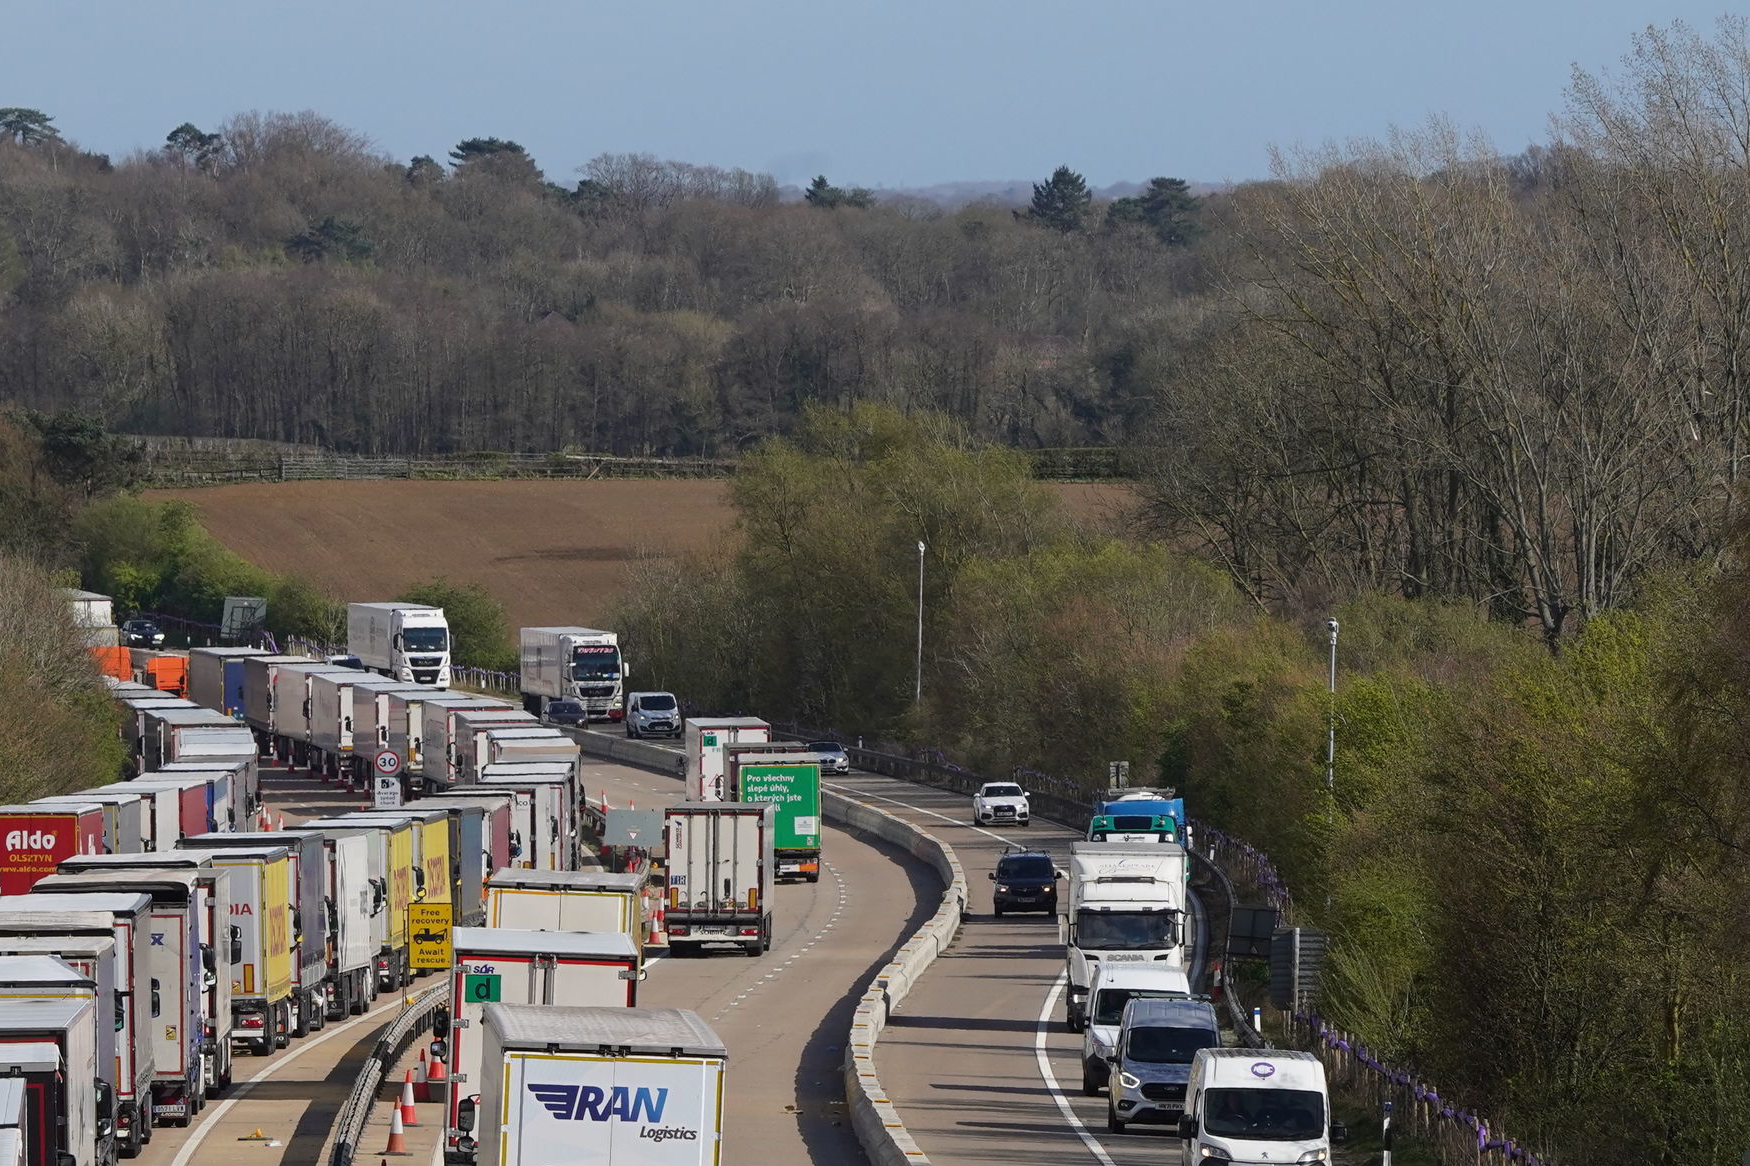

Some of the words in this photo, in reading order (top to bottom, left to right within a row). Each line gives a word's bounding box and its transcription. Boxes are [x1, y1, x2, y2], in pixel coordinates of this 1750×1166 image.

[379, 757, 396, 767] 30
[746, 774, 761, 782] Pro
[763, 774, 795, 784] všechny
[786, 794, 802, 802] jste
[6, 830, 56, 851] Aldo
[9, 854, 52, 863] OLSZTYN
[421, 908, 440, 916] Free
[419, 948, 444, 956] Await
[475, 977, 490, 1000] d
[639, 1125, 698, 1143] Logistics
